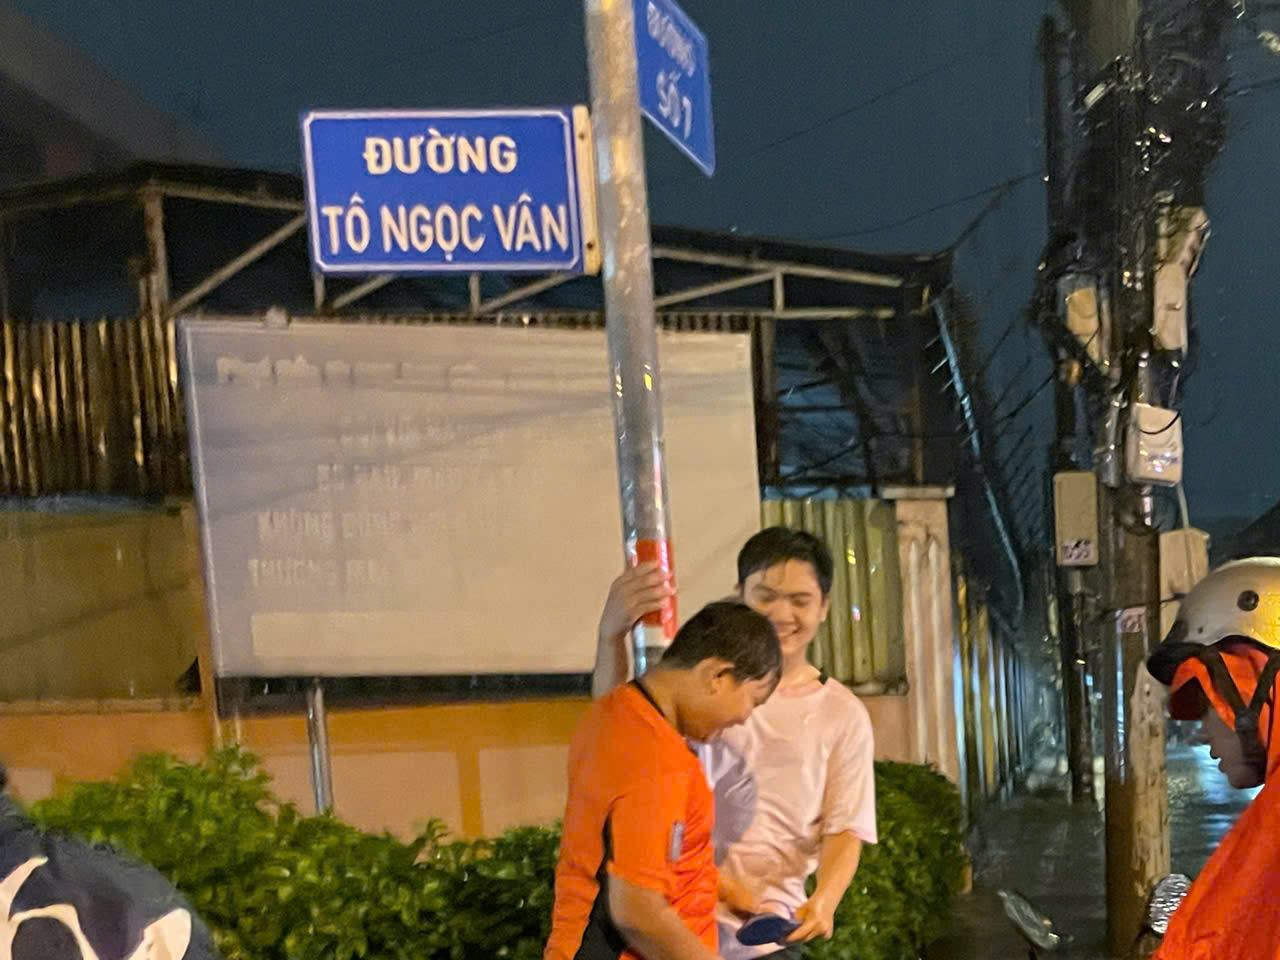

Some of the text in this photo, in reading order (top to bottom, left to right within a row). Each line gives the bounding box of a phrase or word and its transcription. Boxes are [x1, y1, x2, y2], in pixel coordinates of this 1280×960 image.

[363, 128, 518, 175] ĐƯỜNG
[322, 192, 569, 261] TÔ NGỌC VÂN
